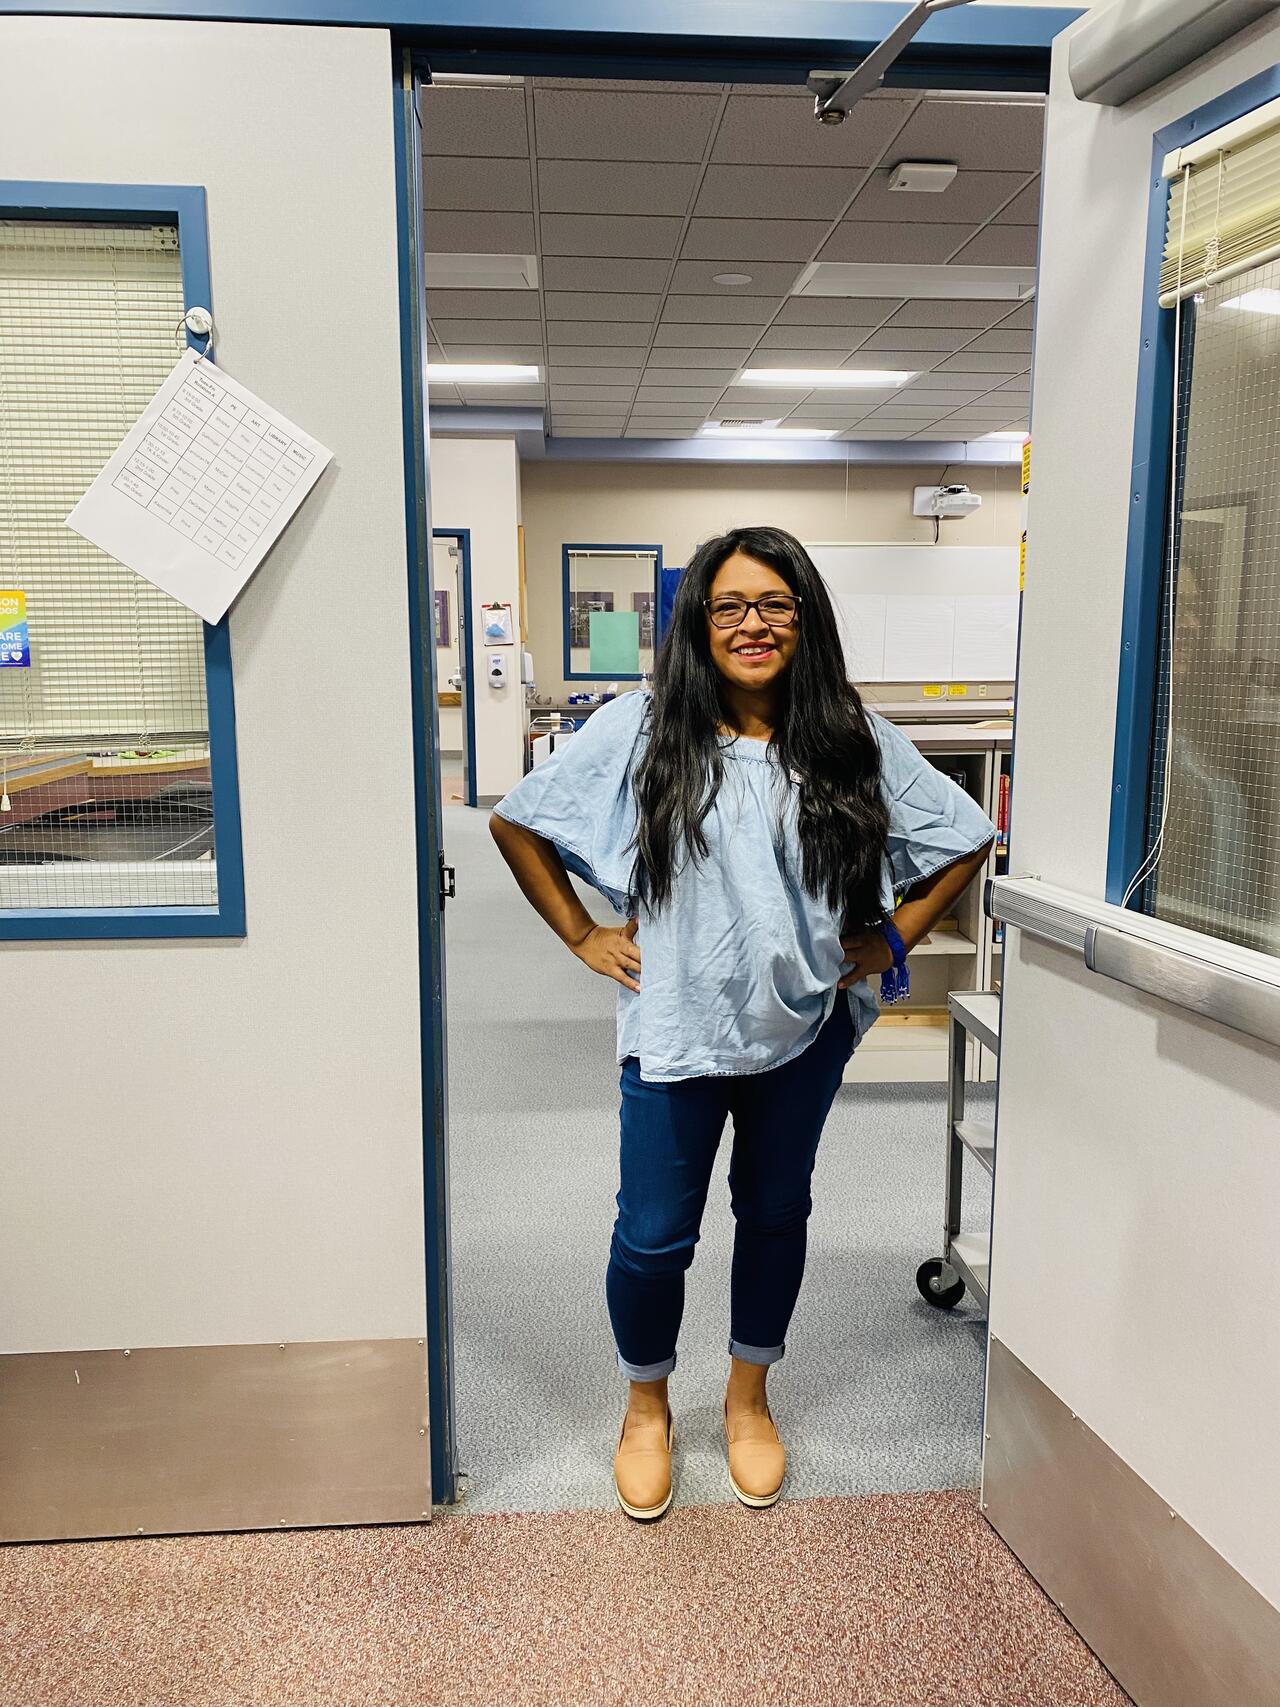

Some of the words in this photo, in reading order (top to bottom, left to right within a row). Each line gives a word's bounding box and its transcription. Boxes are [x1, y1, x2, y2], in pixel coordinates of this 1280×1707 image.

[250, 419, 260, 427] ART
[268, 431, 286, 446] LIBRARY
[292, 449, 306, 460] MUSIC
[0, 598, 18, 606] ON
[0, 632, 22, 641] ARE
[0, 642, 22, 650] OME
